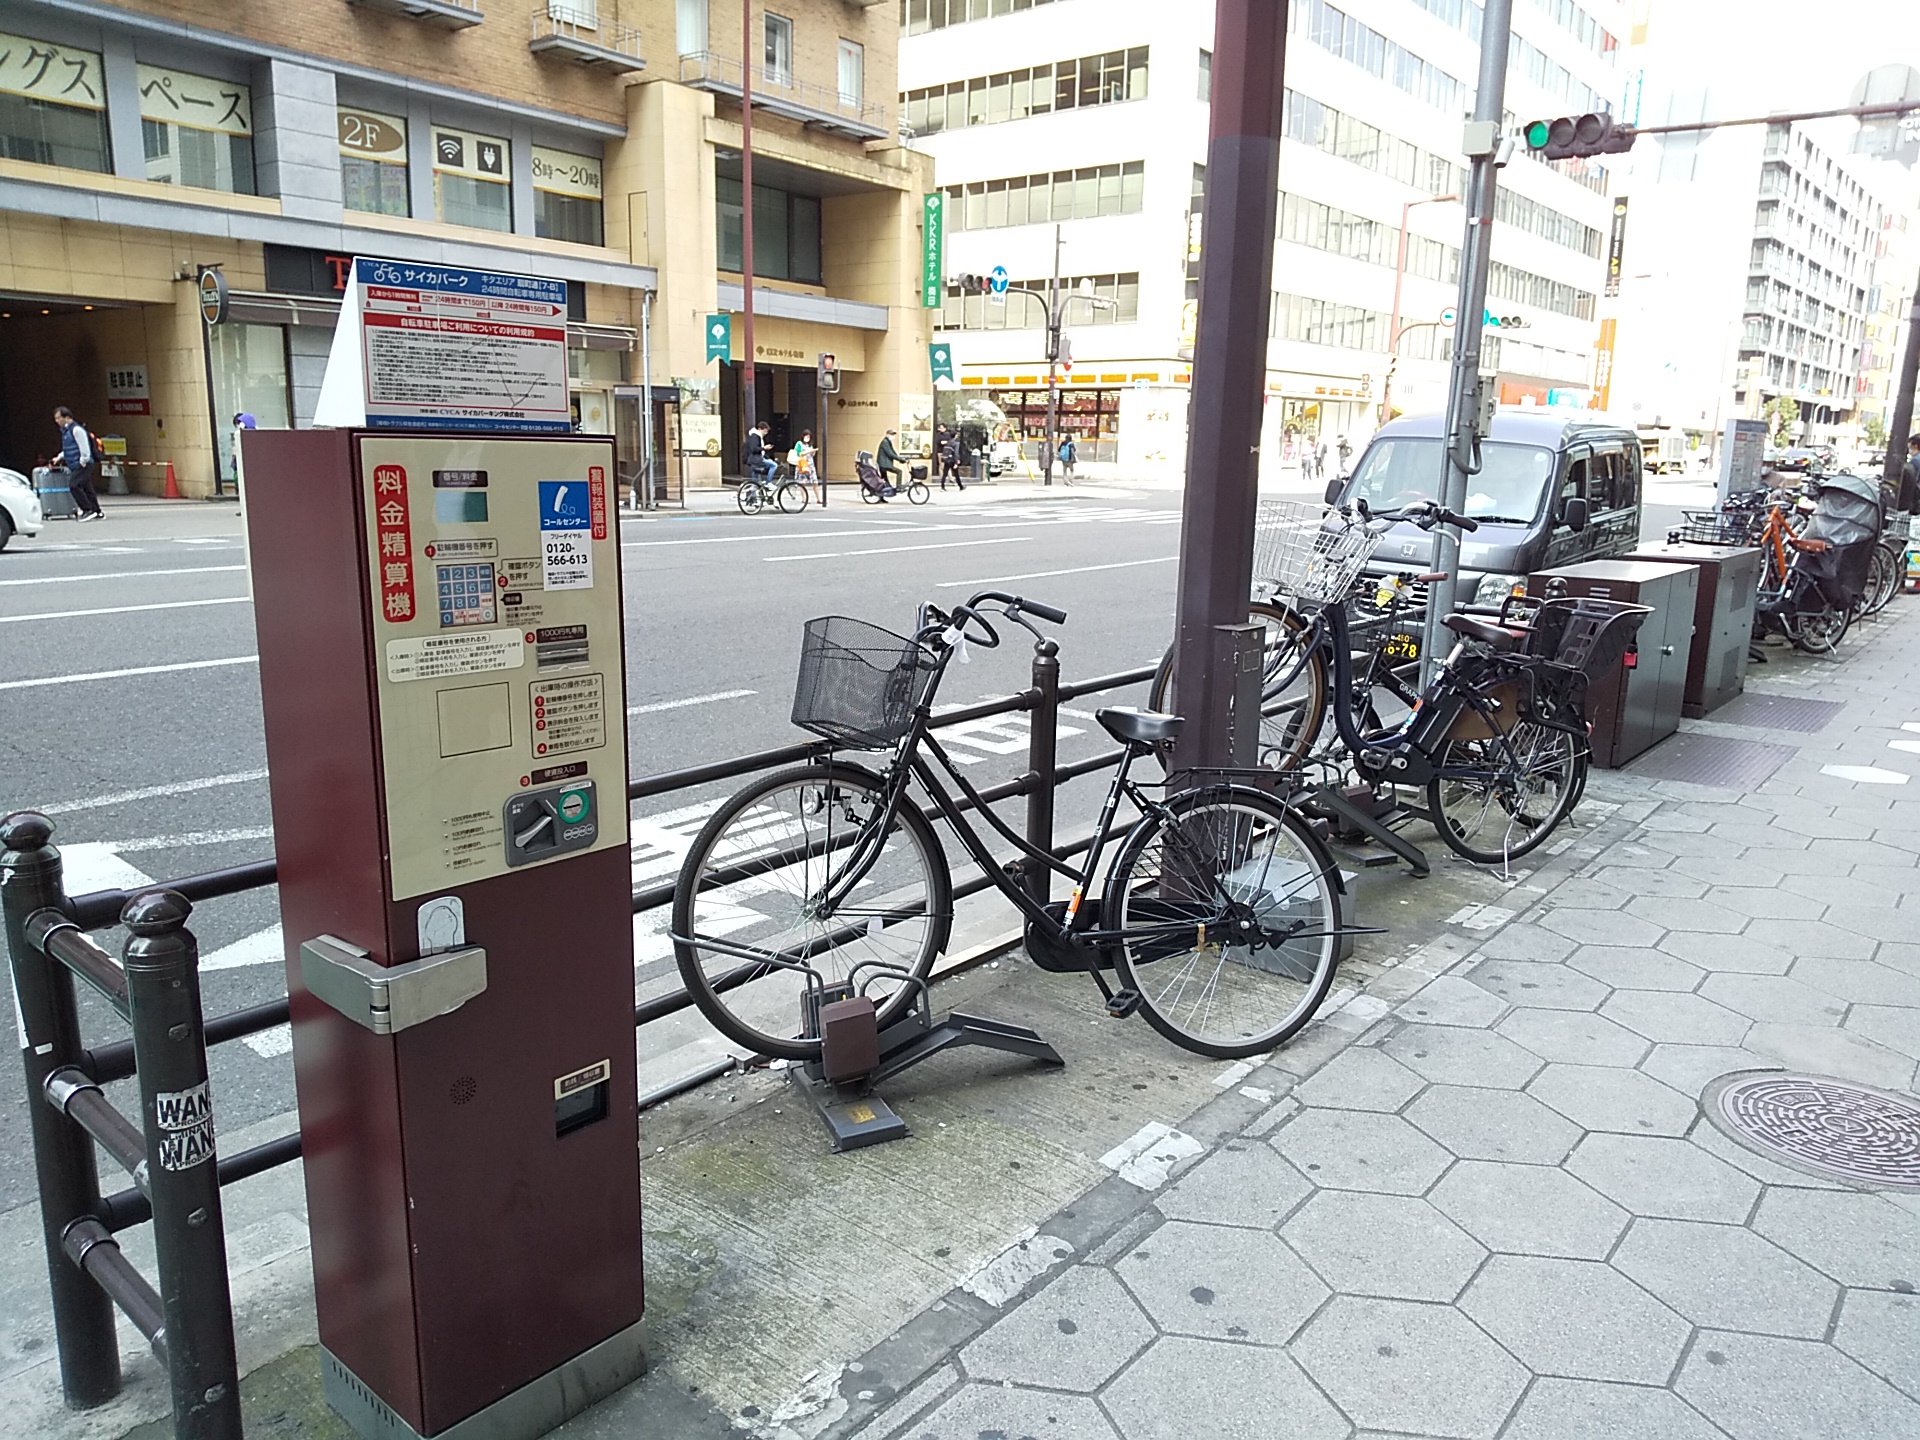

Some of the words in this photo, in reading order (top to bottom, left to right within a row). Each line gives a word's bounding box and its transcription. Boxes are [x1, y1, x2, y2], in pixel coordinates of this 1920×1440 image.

[140, 75, 247, 129] ペース
[343, 115, 381, 148] 2F
[481, 275, 515, 286] キタエリア
[481, 284, 564, 302] 24時間自転車専用駐車場
[400, 317, 536, 338] 自転車駐車場ご利用についての利用規約
[110, 371, 144, 388] 駐車禁止
[443, 472, 478, 481] 番号/料金
[590, 469, 605, 537] 警報装置付
[544, 518, 588, 526] コールセンター
[377, 469, 412, 618] 料金精算機
[546, 543, 576, 554] 0120-
[547, 554, 588, 566] 566-613
[508, 561, 541, 571] 確認ボタン
[454, 570, 462, 579] 2
[467, 569, 475, 577] 3
[508, 572, 529, 581] を押す
[441, 585, 449, 594] 4
[455, 584, 463, 593] 5
[469, 583, 476, 592] 6
[442, 599, 450, 609] 7
[456, 598, 463, 608] 8
[469, 597, 477, 607] 9
[443, 614, 451, 623] 0
